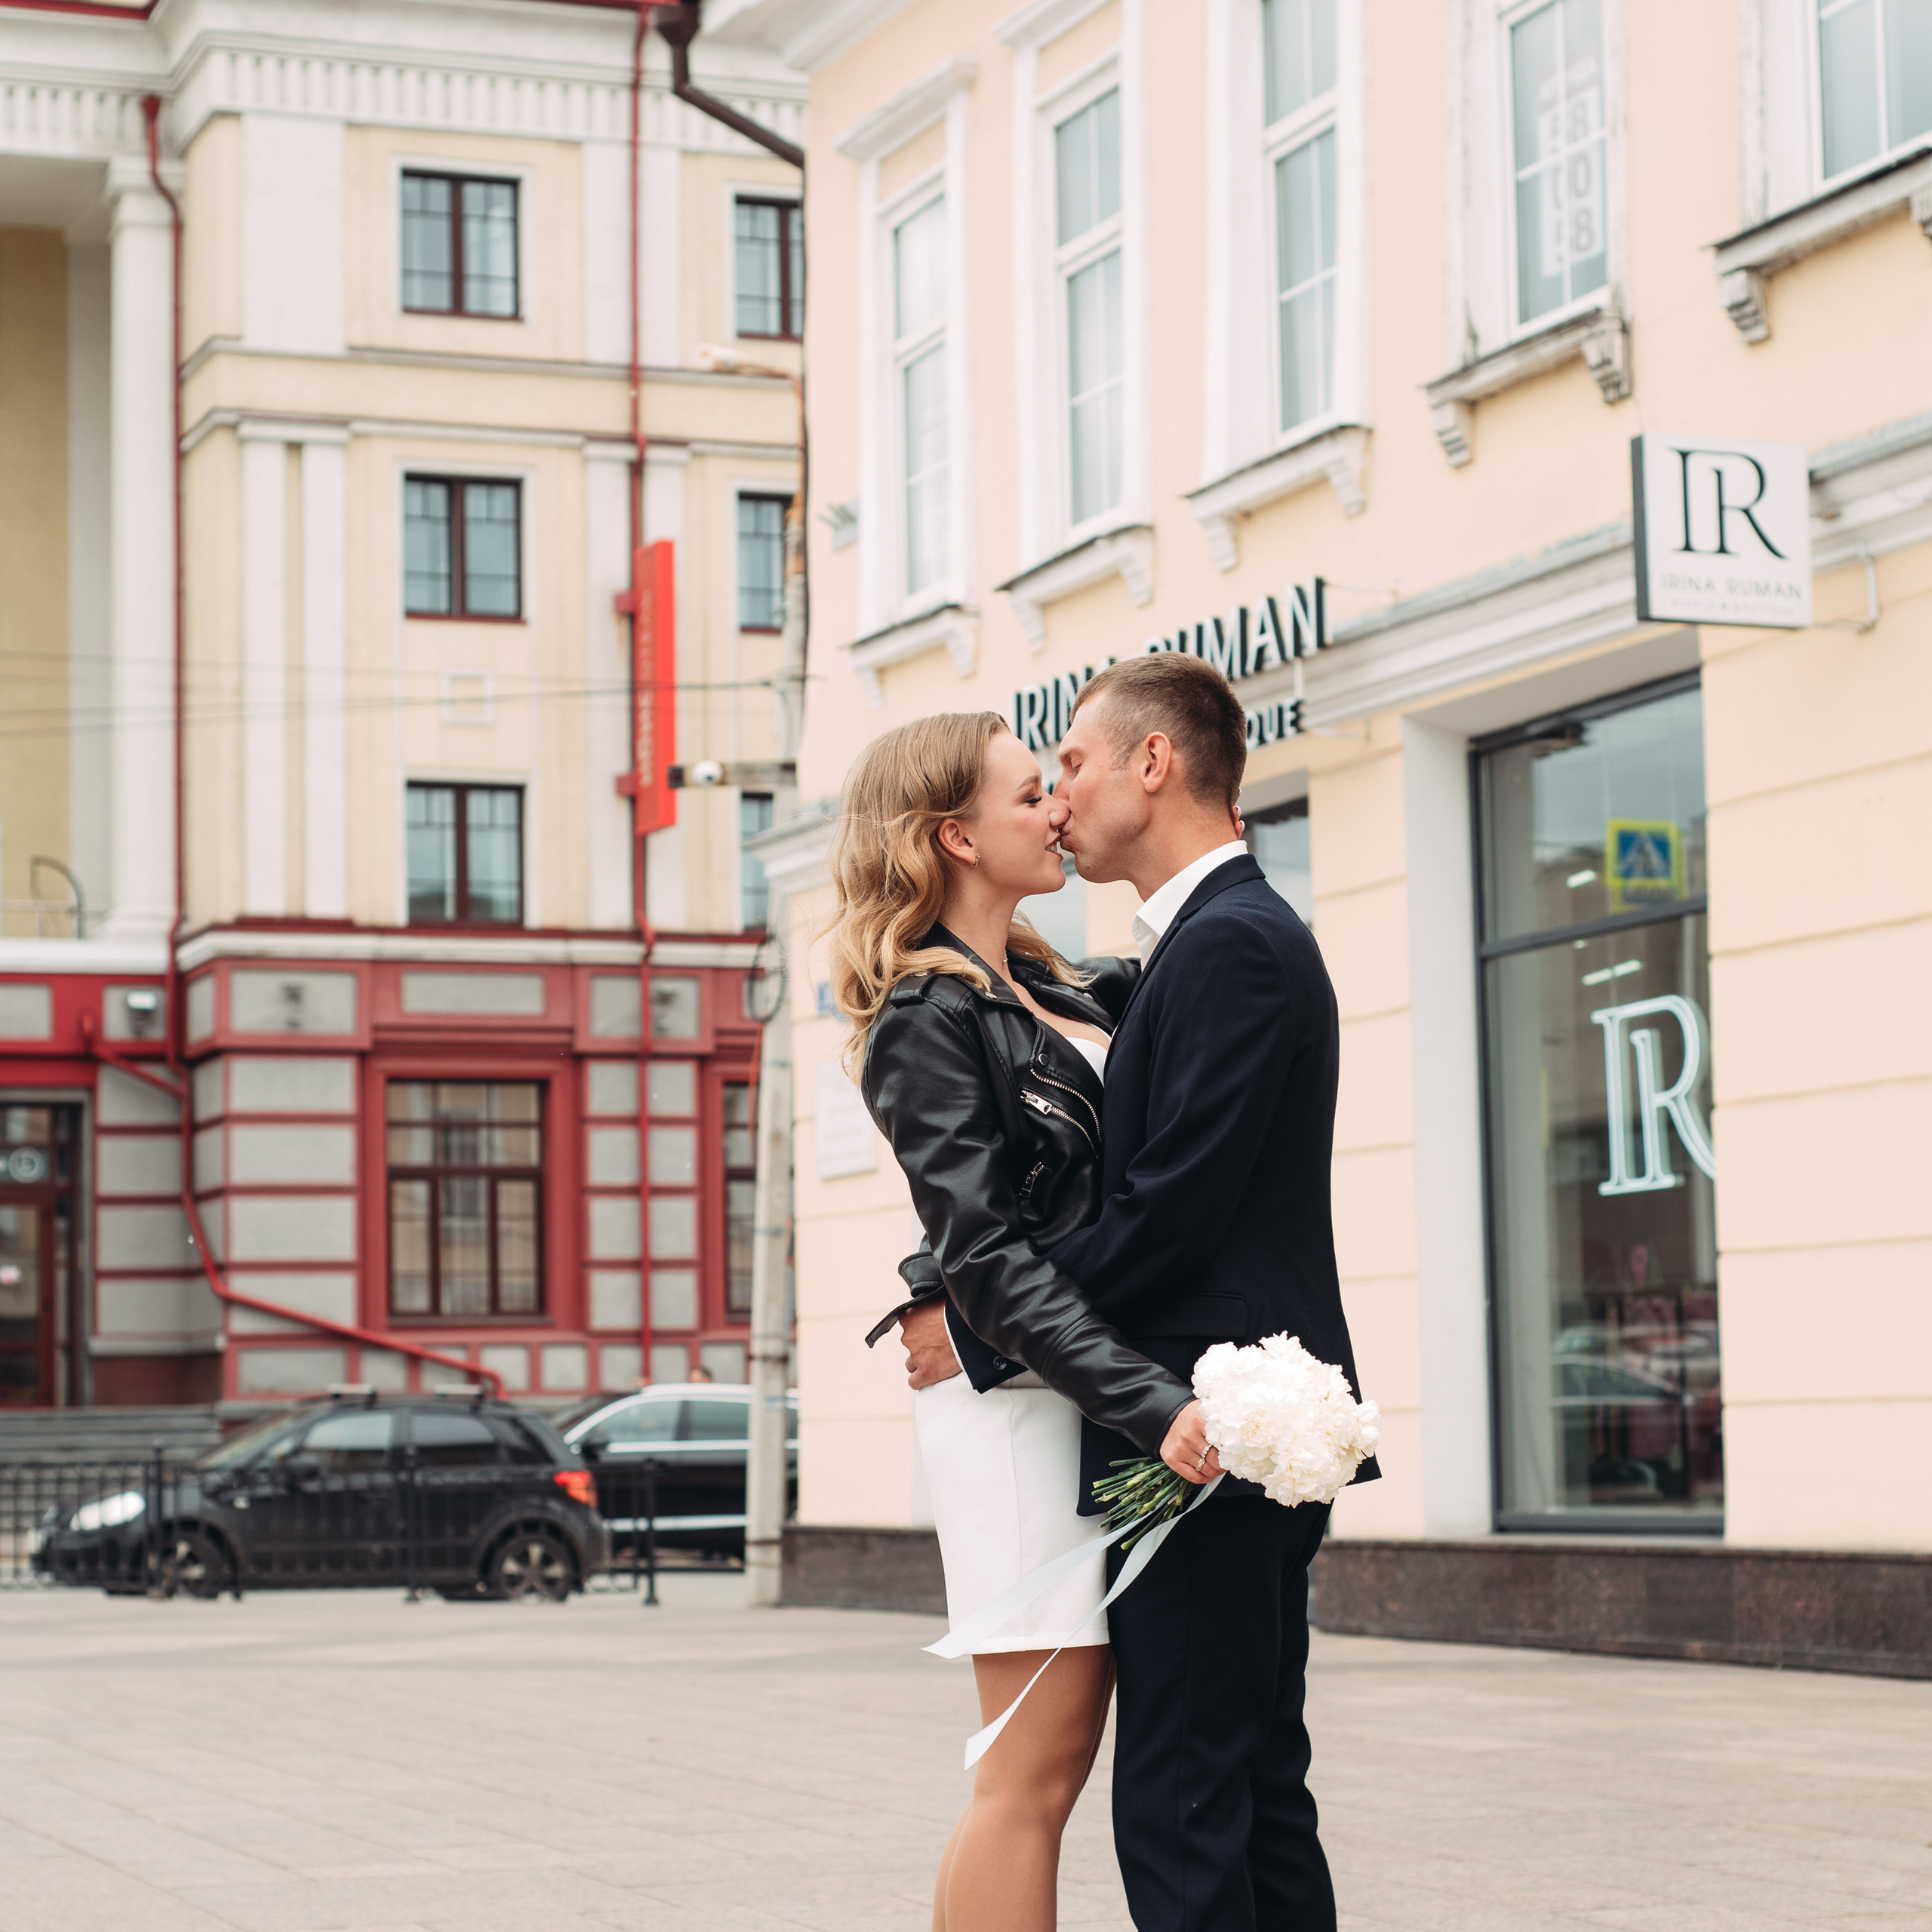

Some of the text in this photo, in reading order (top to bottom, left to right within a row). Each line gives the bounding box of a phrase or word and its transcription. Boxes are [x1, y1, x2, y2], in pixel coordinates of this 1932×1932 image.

[1668, 448, 1788, 561] IR
[1660, 573, 1802, 599] IRINA RUMAN
[1010, 577, 1333, 750] IRIN MAN
[1591, 995, 1717, 1196] IR
